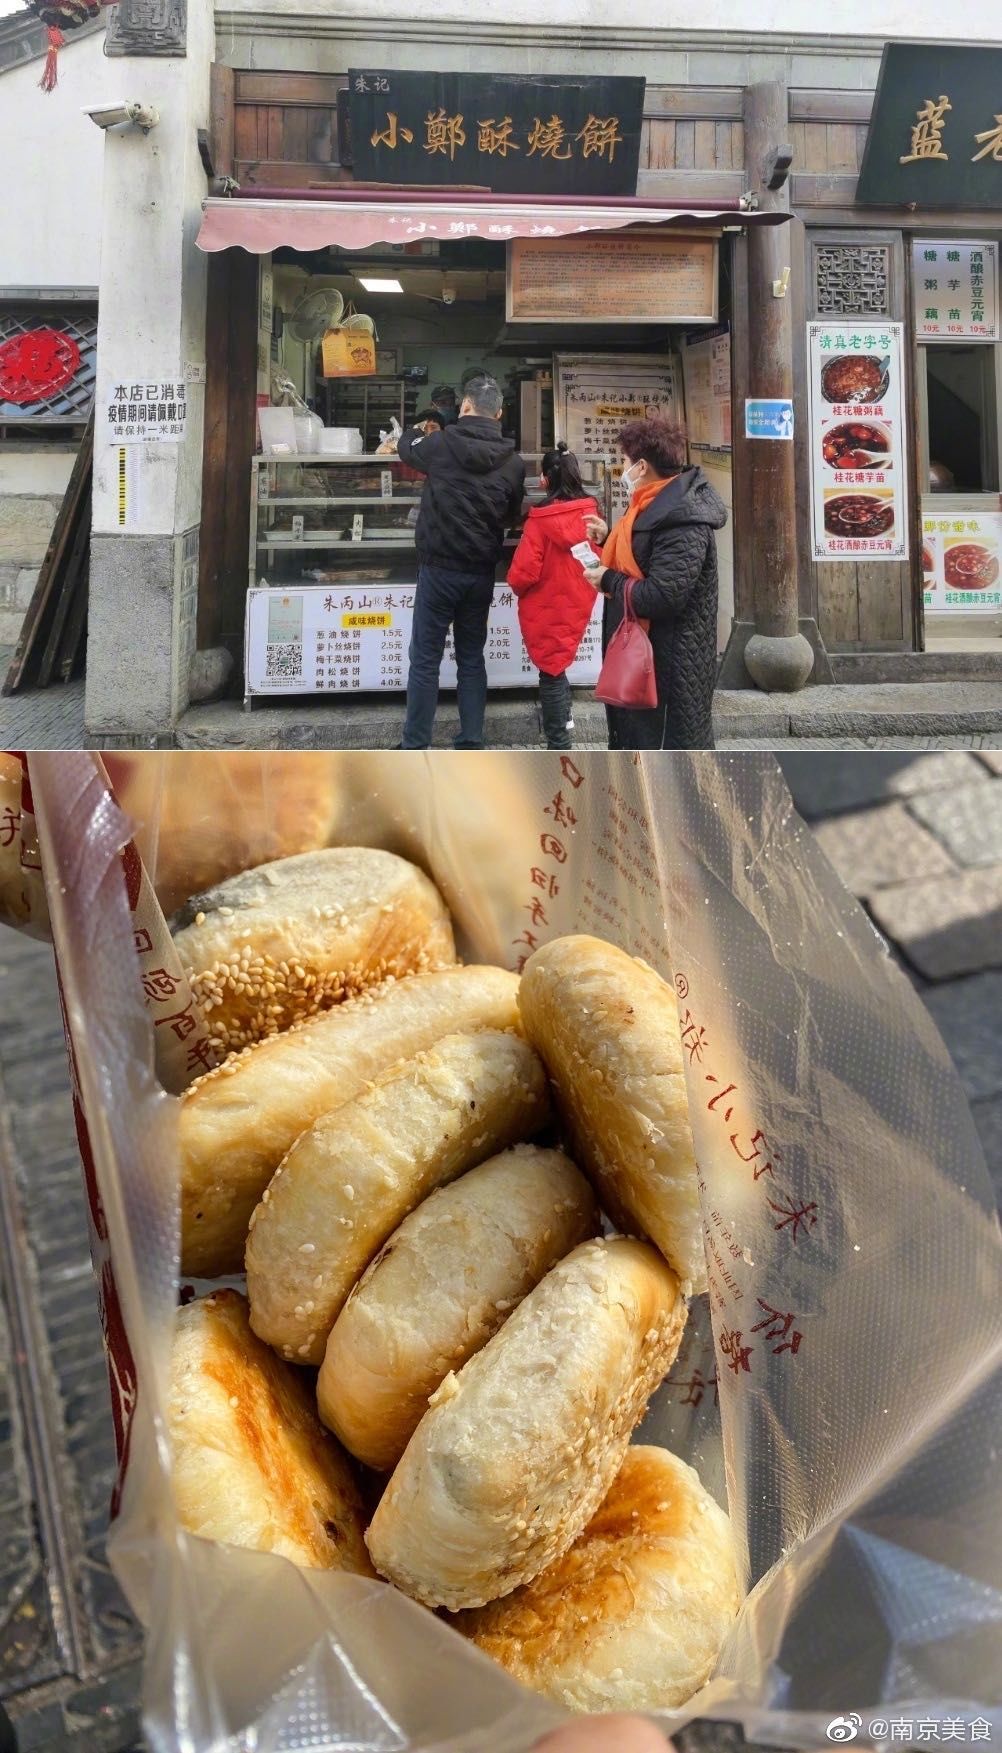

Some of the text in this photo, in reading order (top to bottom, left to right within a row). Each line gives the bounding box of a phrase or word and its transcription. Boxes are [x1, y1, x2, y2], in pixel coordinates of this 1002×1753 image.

[354, 75, 391, 93] 朱记
[970, 251, 984, 321] 酒酿赤豆元宵
[819, 334, 892, 350] 清真老字号
[832, 405, 884, 417] 桂花糖粥藕
[834, 472, 885, 484] 桂花糖芋苗
[316, 641, 403, 651] 萝卜丝烧饼 2.5元
[489, 638, 511, 647] 2.0元
[316, 653, 403, 664] 梅干菜烧饼 3.0元
[489, 651, 511, 660] 2.0元
[316, 666, 403, 676] 肉松烧饼 3.5元
[381, 678, 403, 687] 4.0元
